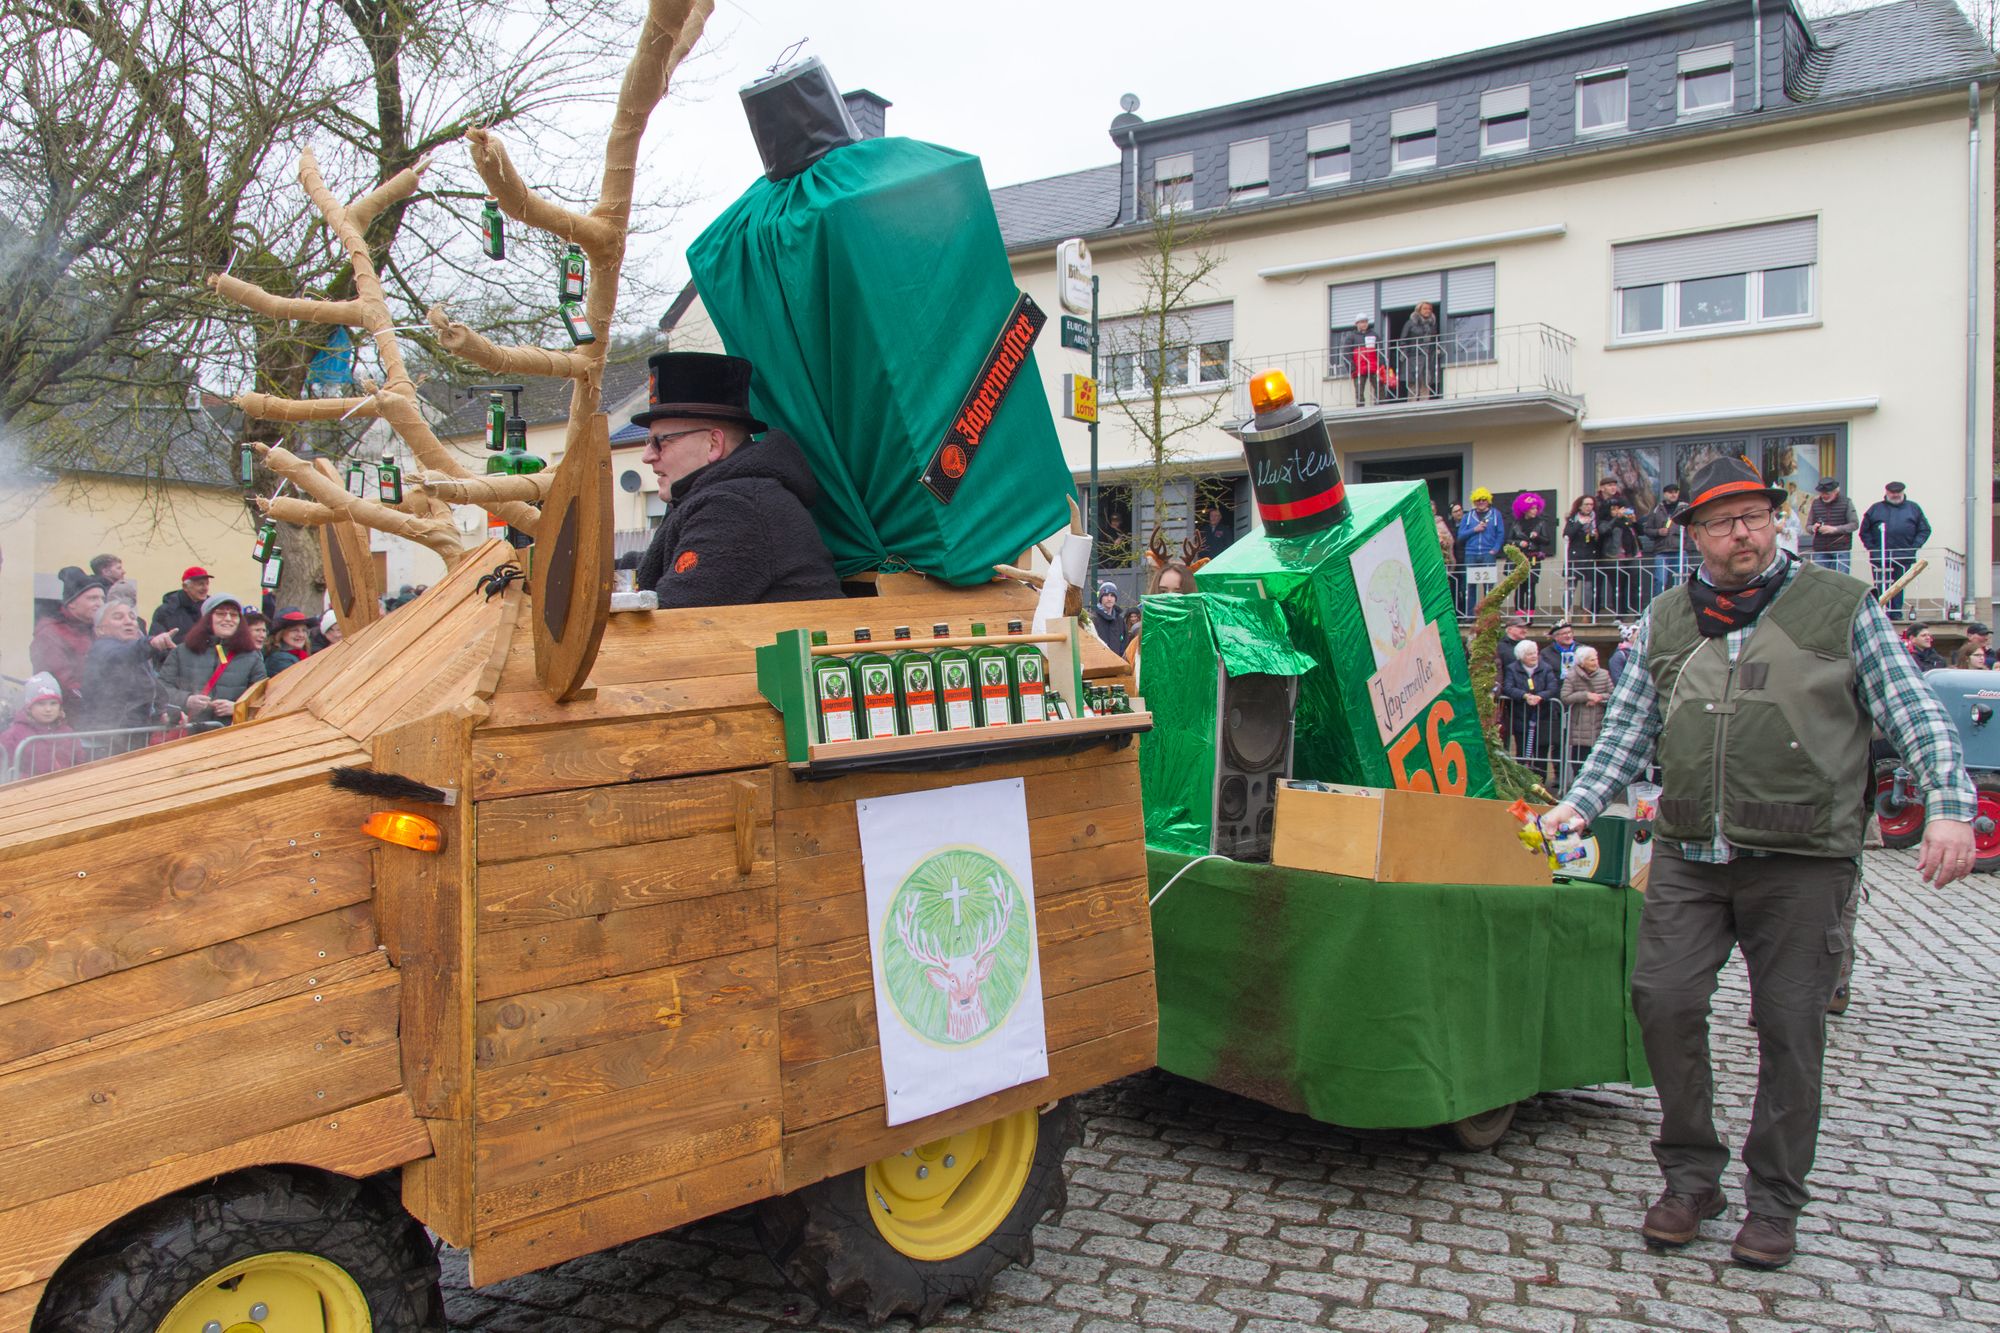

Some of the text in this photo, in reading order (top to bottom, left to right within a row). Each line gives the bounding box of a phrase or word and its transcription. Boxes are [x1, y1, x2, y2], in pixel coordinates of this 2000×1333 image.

[1066, 320, 1083, 333] EURO
[1076, 403, 1095, 417] LOTTO
[1474, 571, 1490, 581] 32
[1387, 700, 1468, 797] 56
